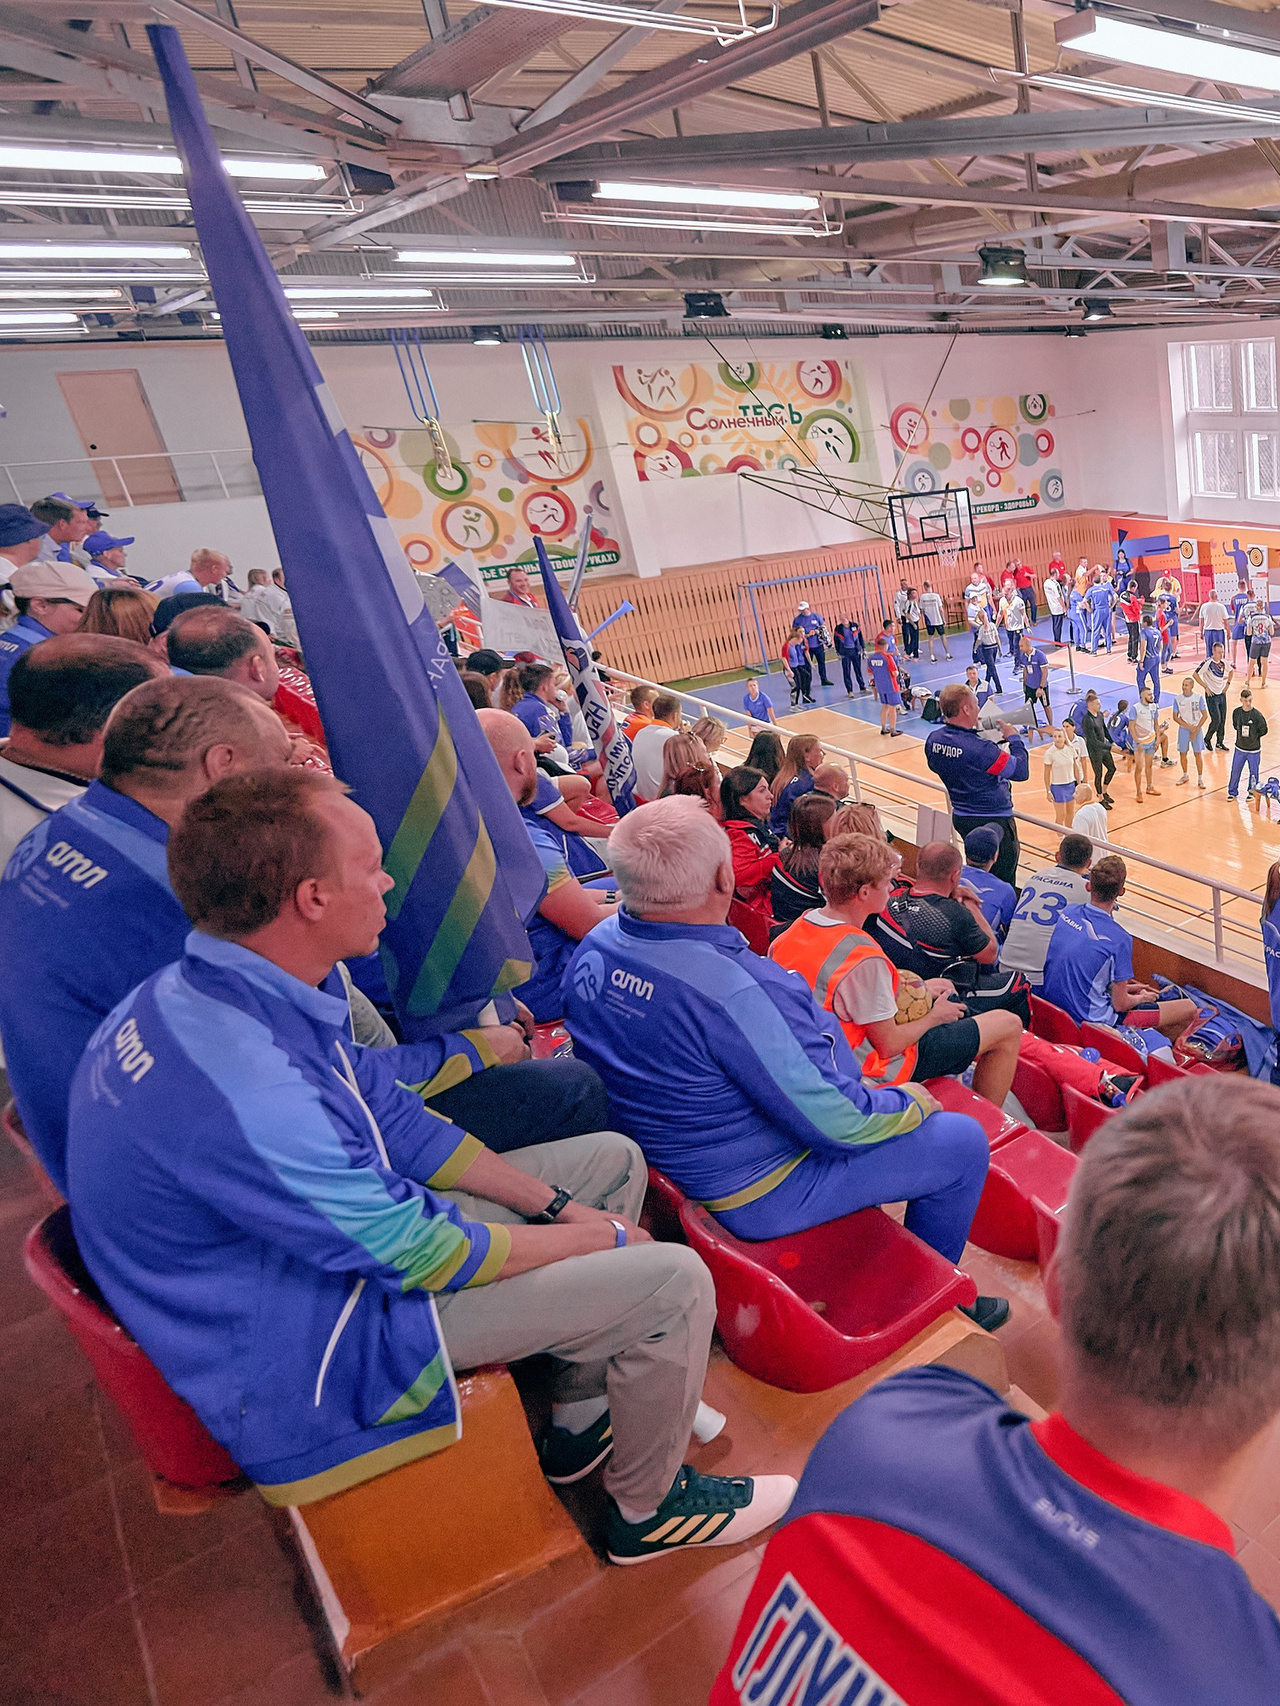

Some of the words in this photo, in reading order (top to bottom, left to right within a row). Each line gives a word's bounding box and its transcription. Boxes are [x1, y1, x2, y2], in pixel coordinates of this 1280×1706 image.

[686, 407, 784, 430] Солнечный
[976, 505, 1000, 514] РЕКОРД
[932, 742, 963, 758] КРУДОР
[1013, 886, 1068, 927] 23
